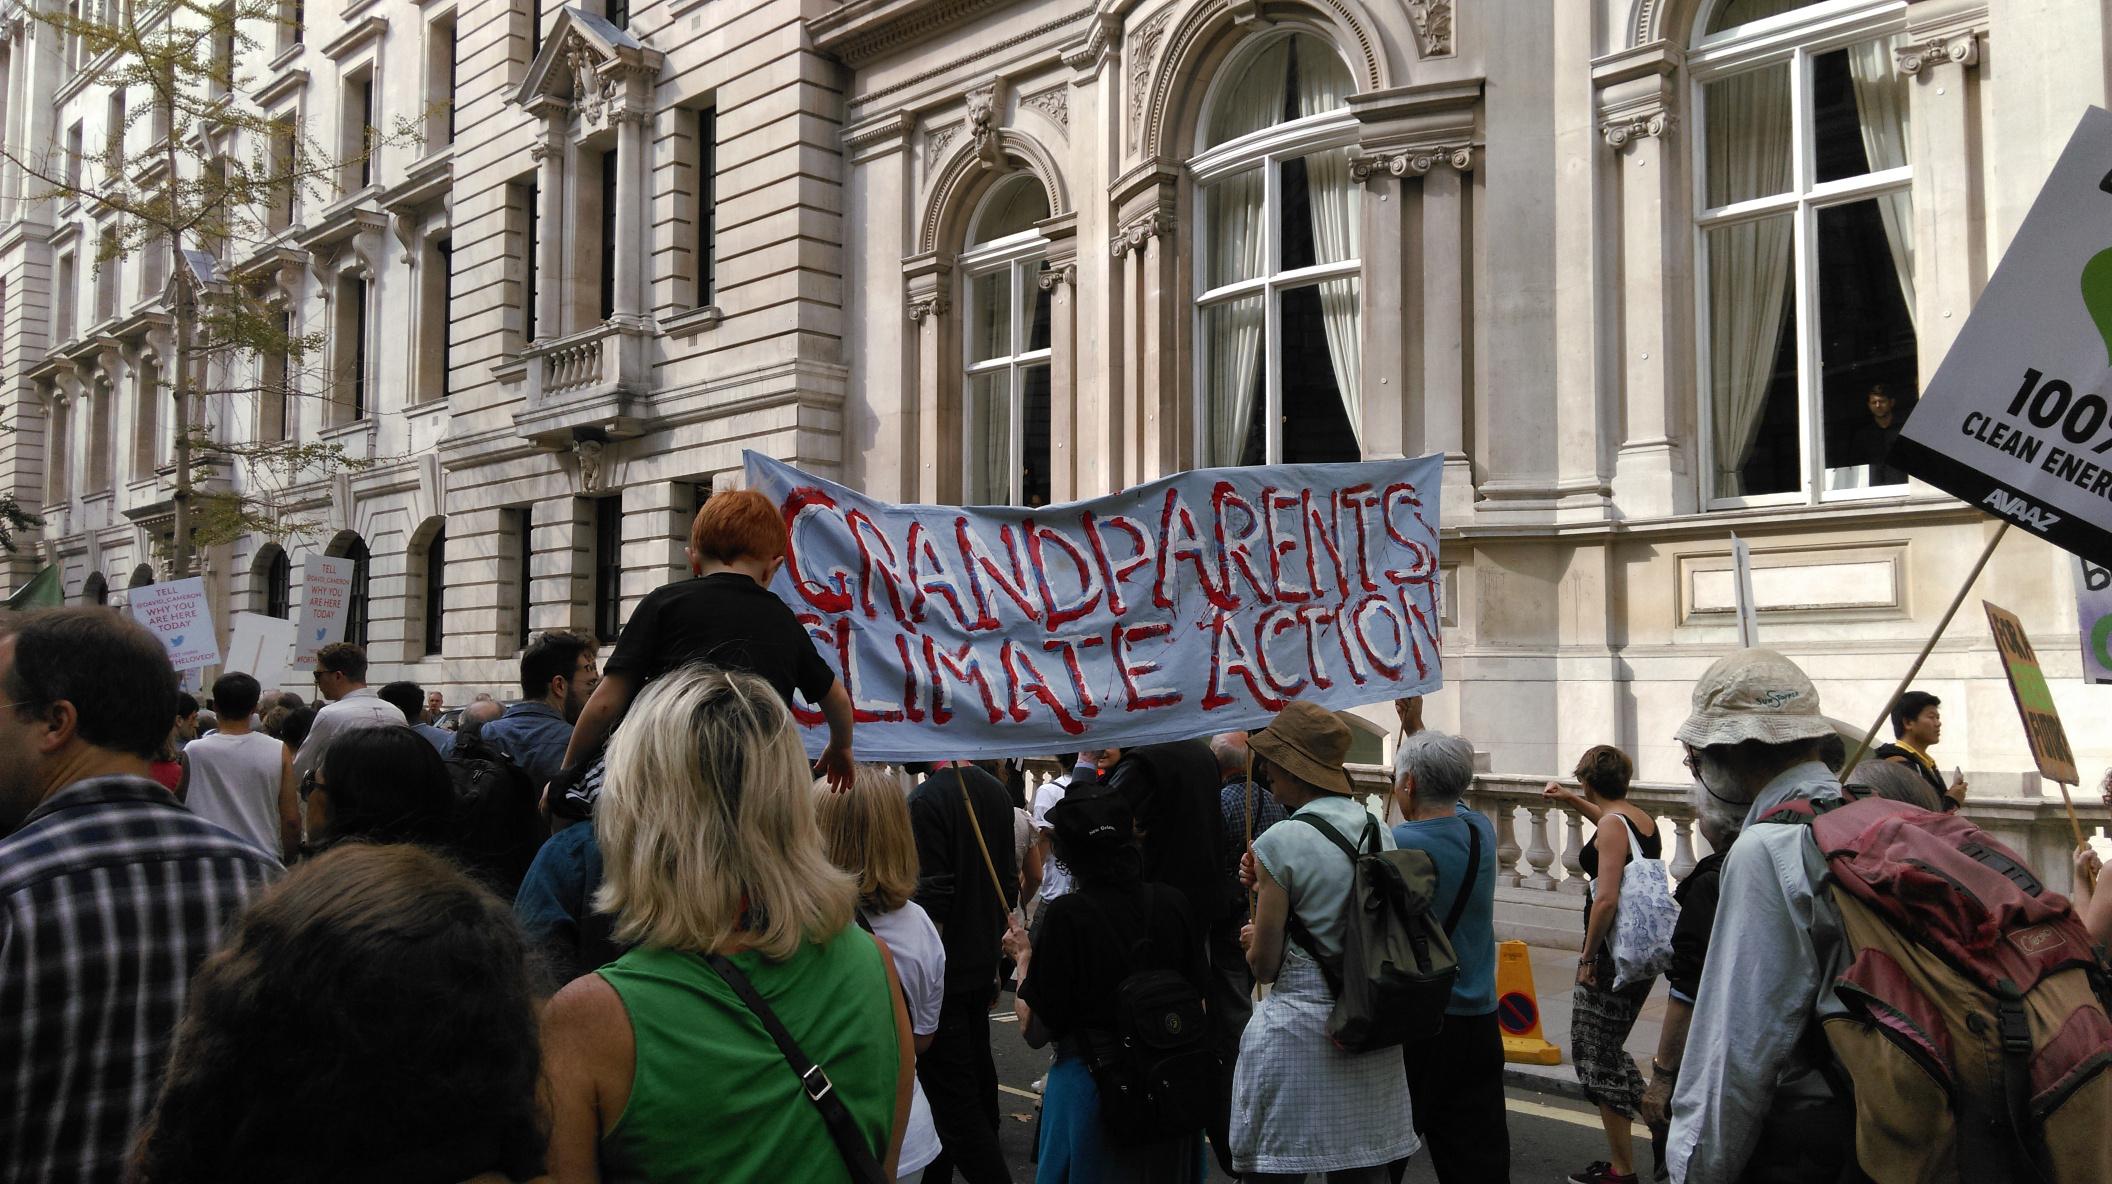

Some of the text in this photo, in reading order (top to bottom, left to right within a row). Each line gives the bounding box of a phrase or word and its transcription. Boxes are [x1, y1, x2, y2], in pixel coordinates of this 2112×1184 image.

[1962, 411, 2044, 464] CLEAN
[1982, 488, 2062, 533] AVAAZ
[781, 480, 1438, 633] GRANDPARENTS
[322, 563, 337, 574] TELL
[156, 586, 178, 597] TELL
[311, 585, 343, 597] WHY YOU
[146, 602, 195, 617] WHY YOU
[309, 598, 342, 609] ARE HERE
[149, 609, 198, 626] ARE HERE
[312, 609, 336, 619] TODAY
[157, 620, 191, 633] TODAY
[1198, 579, 1442, 712] ACTION
